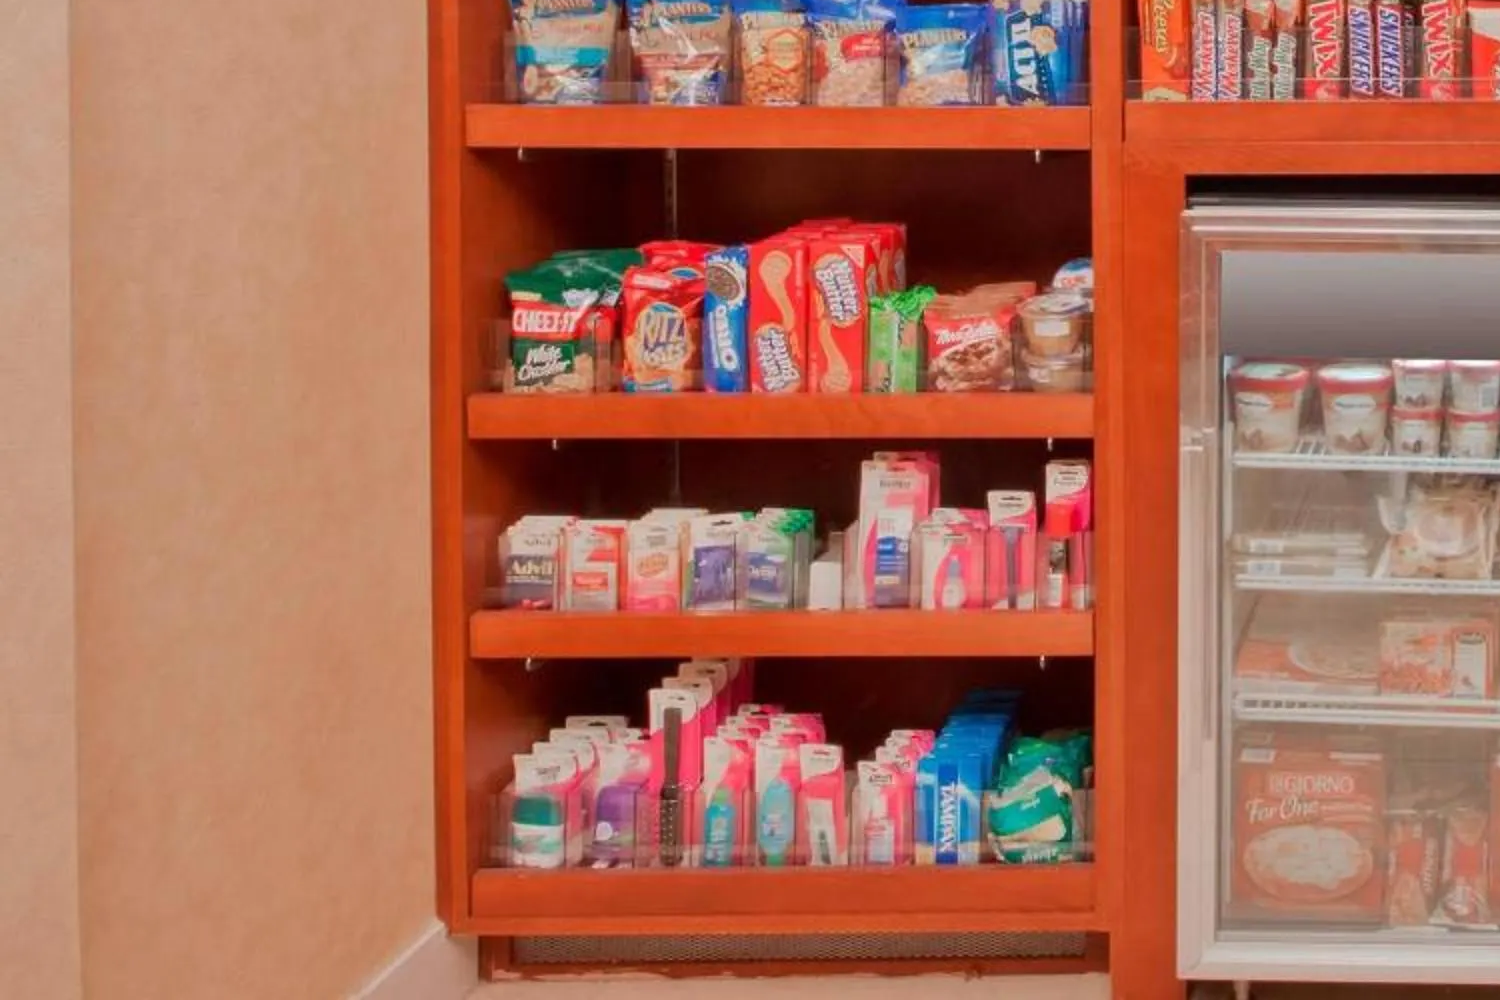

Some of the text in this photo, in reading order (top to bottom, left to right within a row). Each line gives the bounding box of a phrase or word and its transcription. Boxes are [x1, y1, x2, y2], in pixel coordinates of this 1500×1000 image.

[1349, 6, 1373, 94] SNICKERS
[1379, 6, 1403, 96] SNICKERS
[939, 779, 958, 854] TAMPAX
